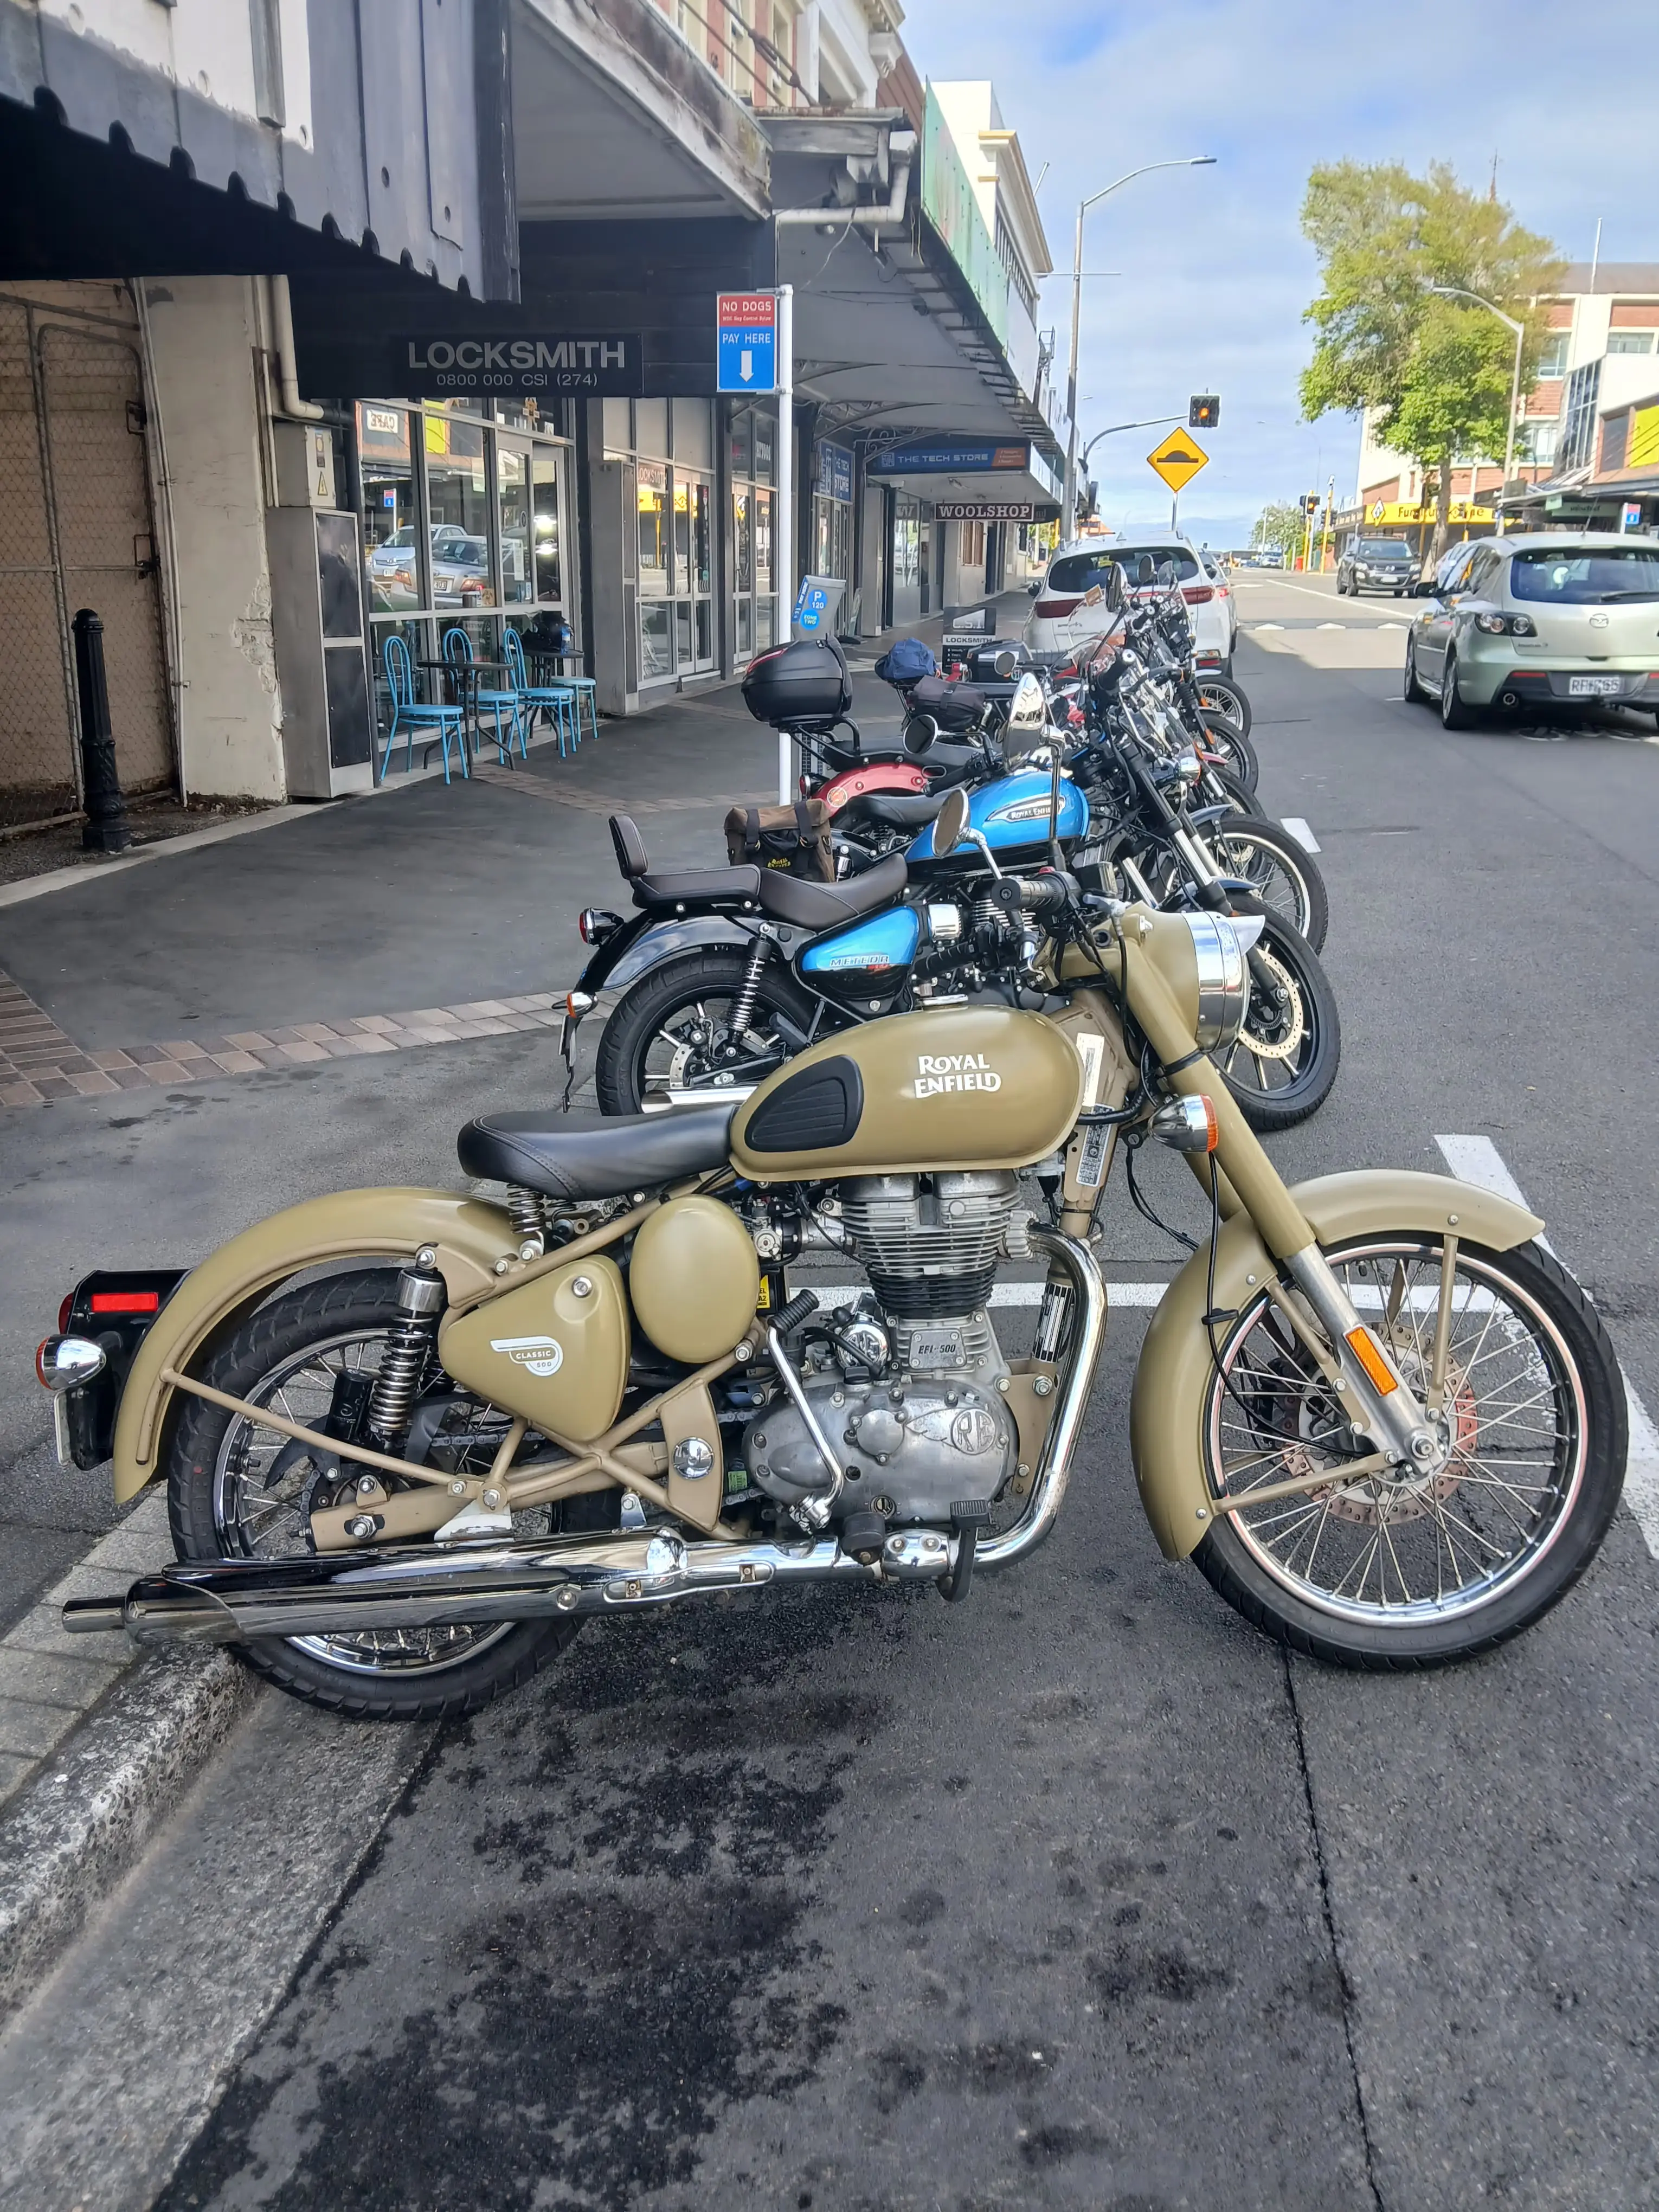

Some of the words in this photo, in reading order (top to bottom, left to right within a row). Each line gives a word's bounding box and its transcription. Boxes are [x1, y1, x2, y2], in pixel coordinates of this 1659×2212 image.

[723, 301, 737, 312] NO
[742, 301, 771, 312] DOGS
[723, 333, 740, 344] PAY
[745, 333, 770, 344] HERE
[408, 341, 625, 369] LOCKSMITH
[436, 374, 477, 386] 0800
[483, 374, 513, 386] 000
[522, 374, 548, 386] CSI
[557, 373, 598, 387] (274)
[953, 453, 988, 461] STORE
[938, 505, 1030, 517] WOOLSHOP
[814, 591, 822, 601] P
[1011, 810, 1033, 819] ROYAL
[831, 955, 889, 966] METEOR
[918, 1053, 990, 1075] ROYAL
[914, 1072, 1001, 1098] ENFIELD
[516, 1350, 551, 1359] CLASSIC
